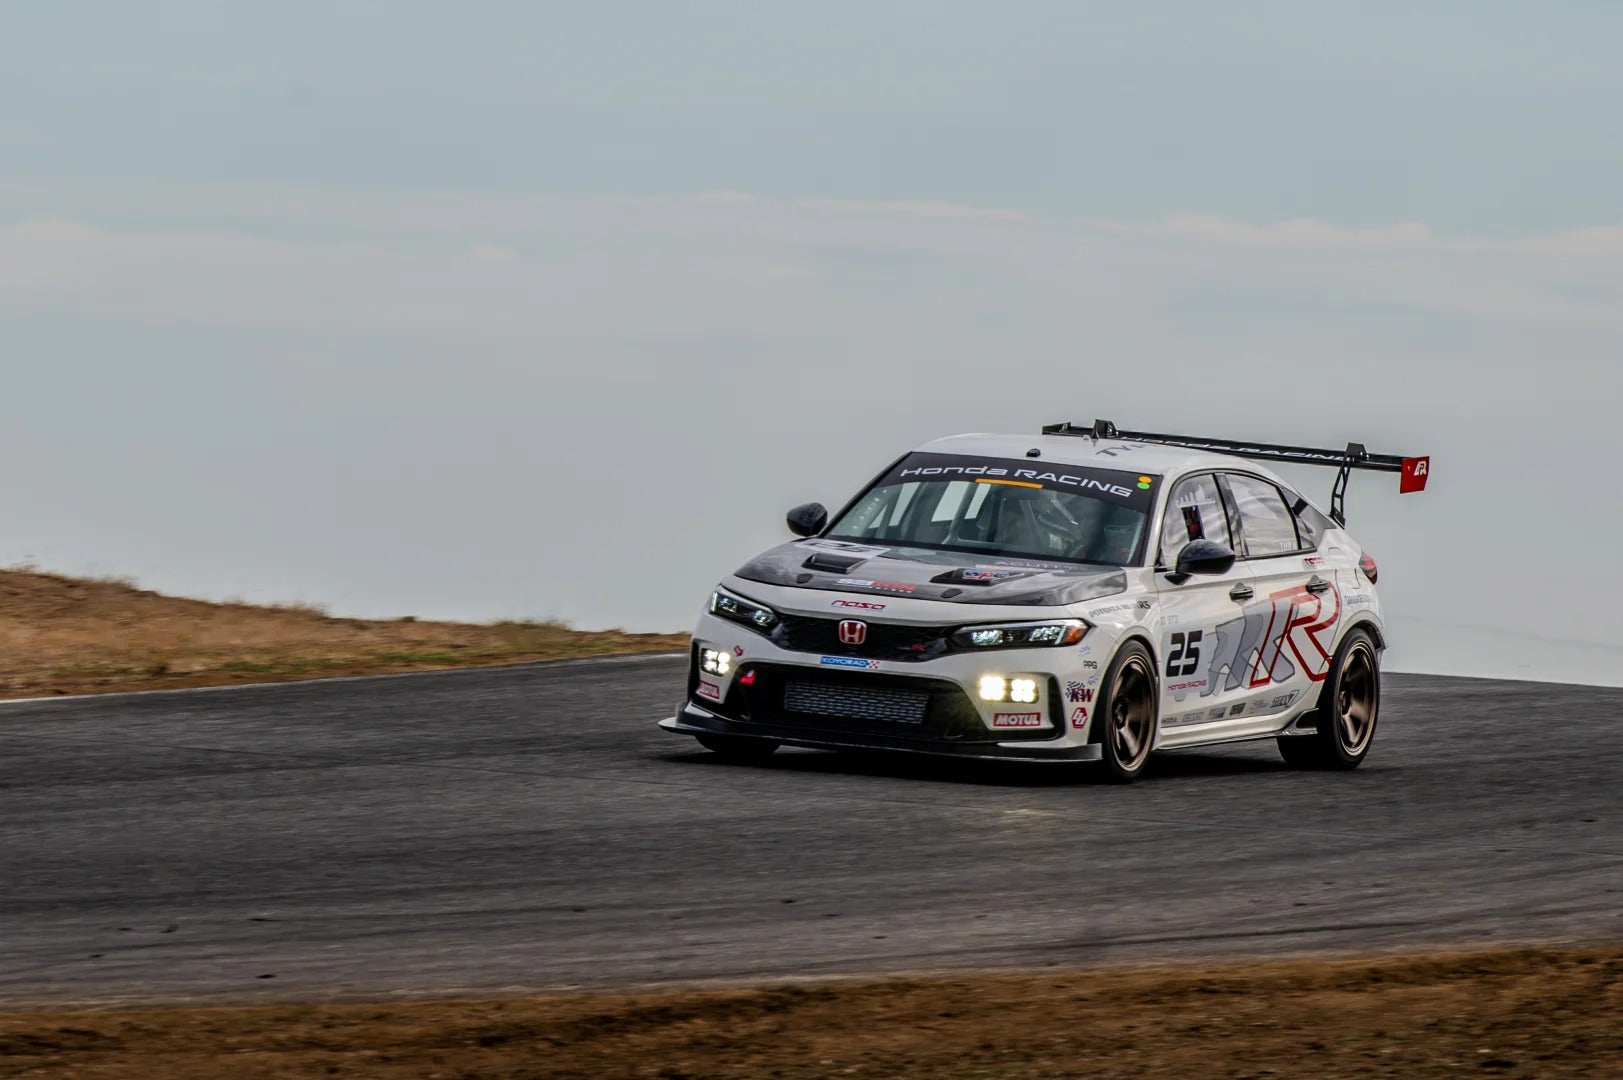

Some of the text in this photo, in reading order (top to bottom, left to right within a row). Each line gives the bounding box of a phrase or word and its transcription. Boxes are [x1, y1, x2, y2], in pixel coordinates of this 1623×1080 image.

[1013, 469, 1133, 497] RACING
[1166, 629, 1203, 678] 25
[995, 714, 1040, 725] MOTUL
